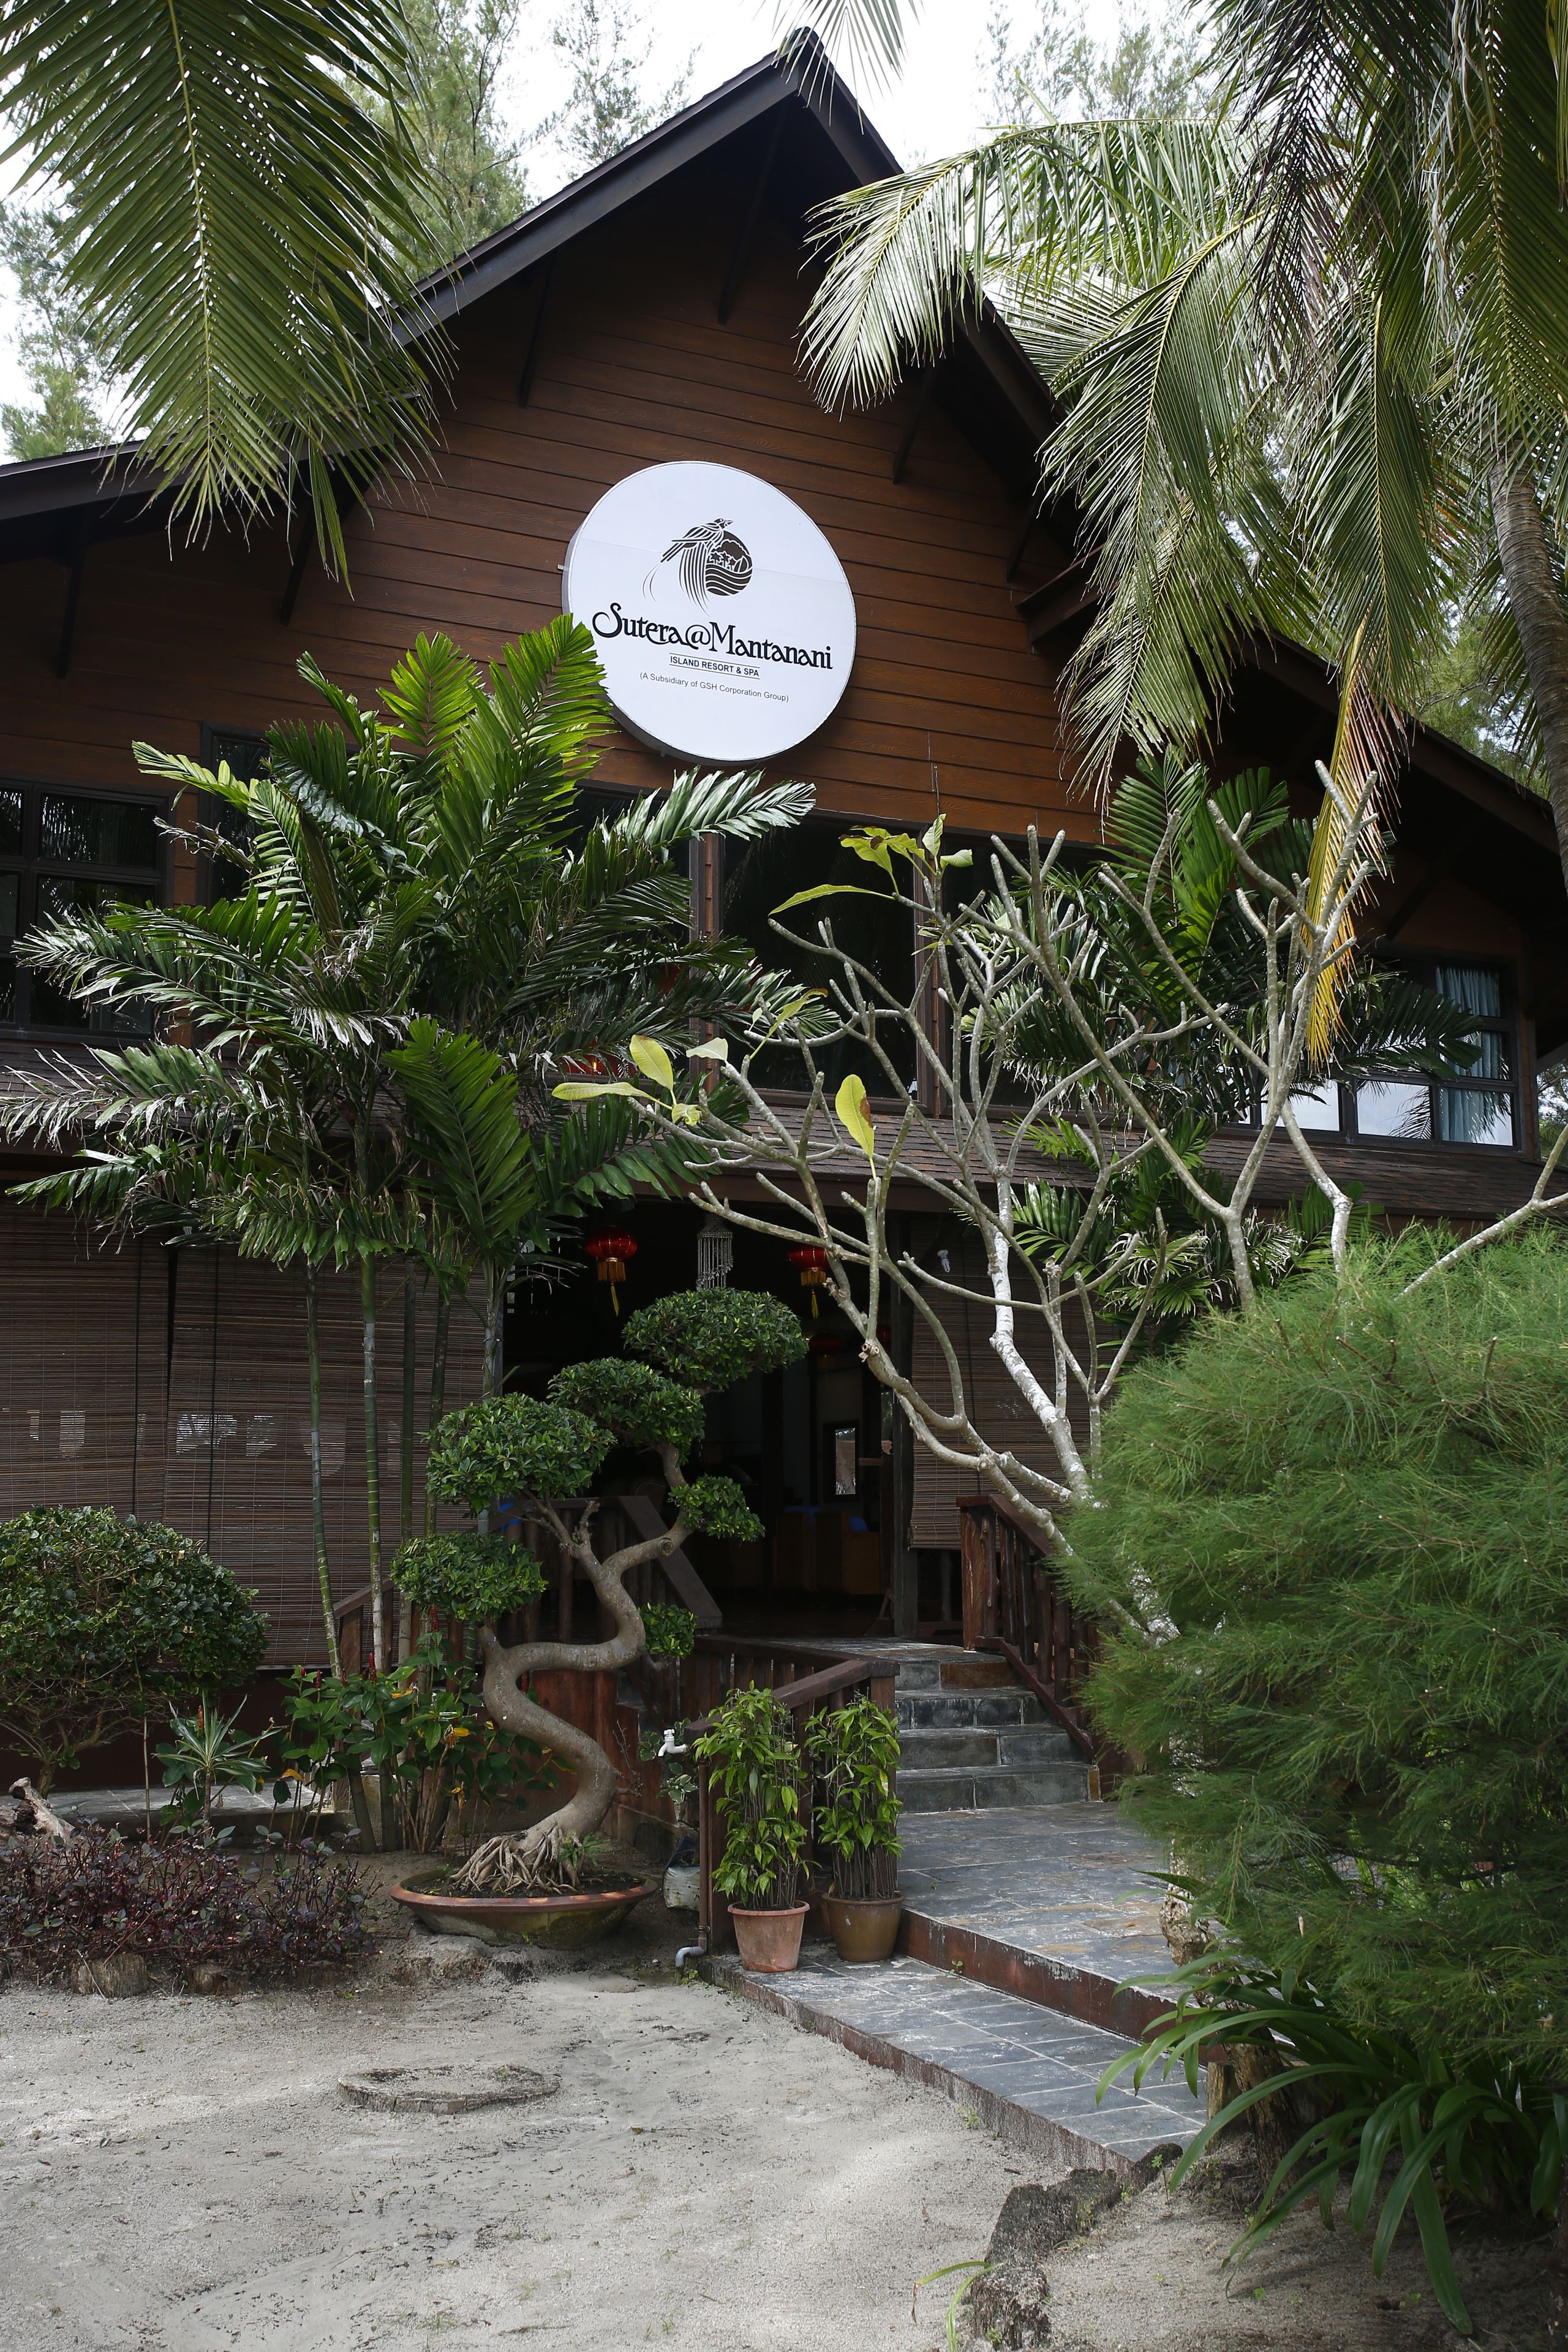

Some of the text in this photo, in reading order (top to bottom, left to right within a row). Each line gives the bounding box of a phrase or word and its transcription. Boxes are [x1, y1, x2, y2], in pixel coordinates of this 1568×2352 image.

[670, 655, 699, 668] ISLAND
[701, 661, 734, 673] RESORT
[744, 668, 760, 677] SPA
[639, 671, 649, 680] (A
[650, 673, 688, 688] Subsidiary
[699, 681, 718, 691] GSH
[719, 684, 762, 698] Corporation
[763, 691, 790, 703] Group)
